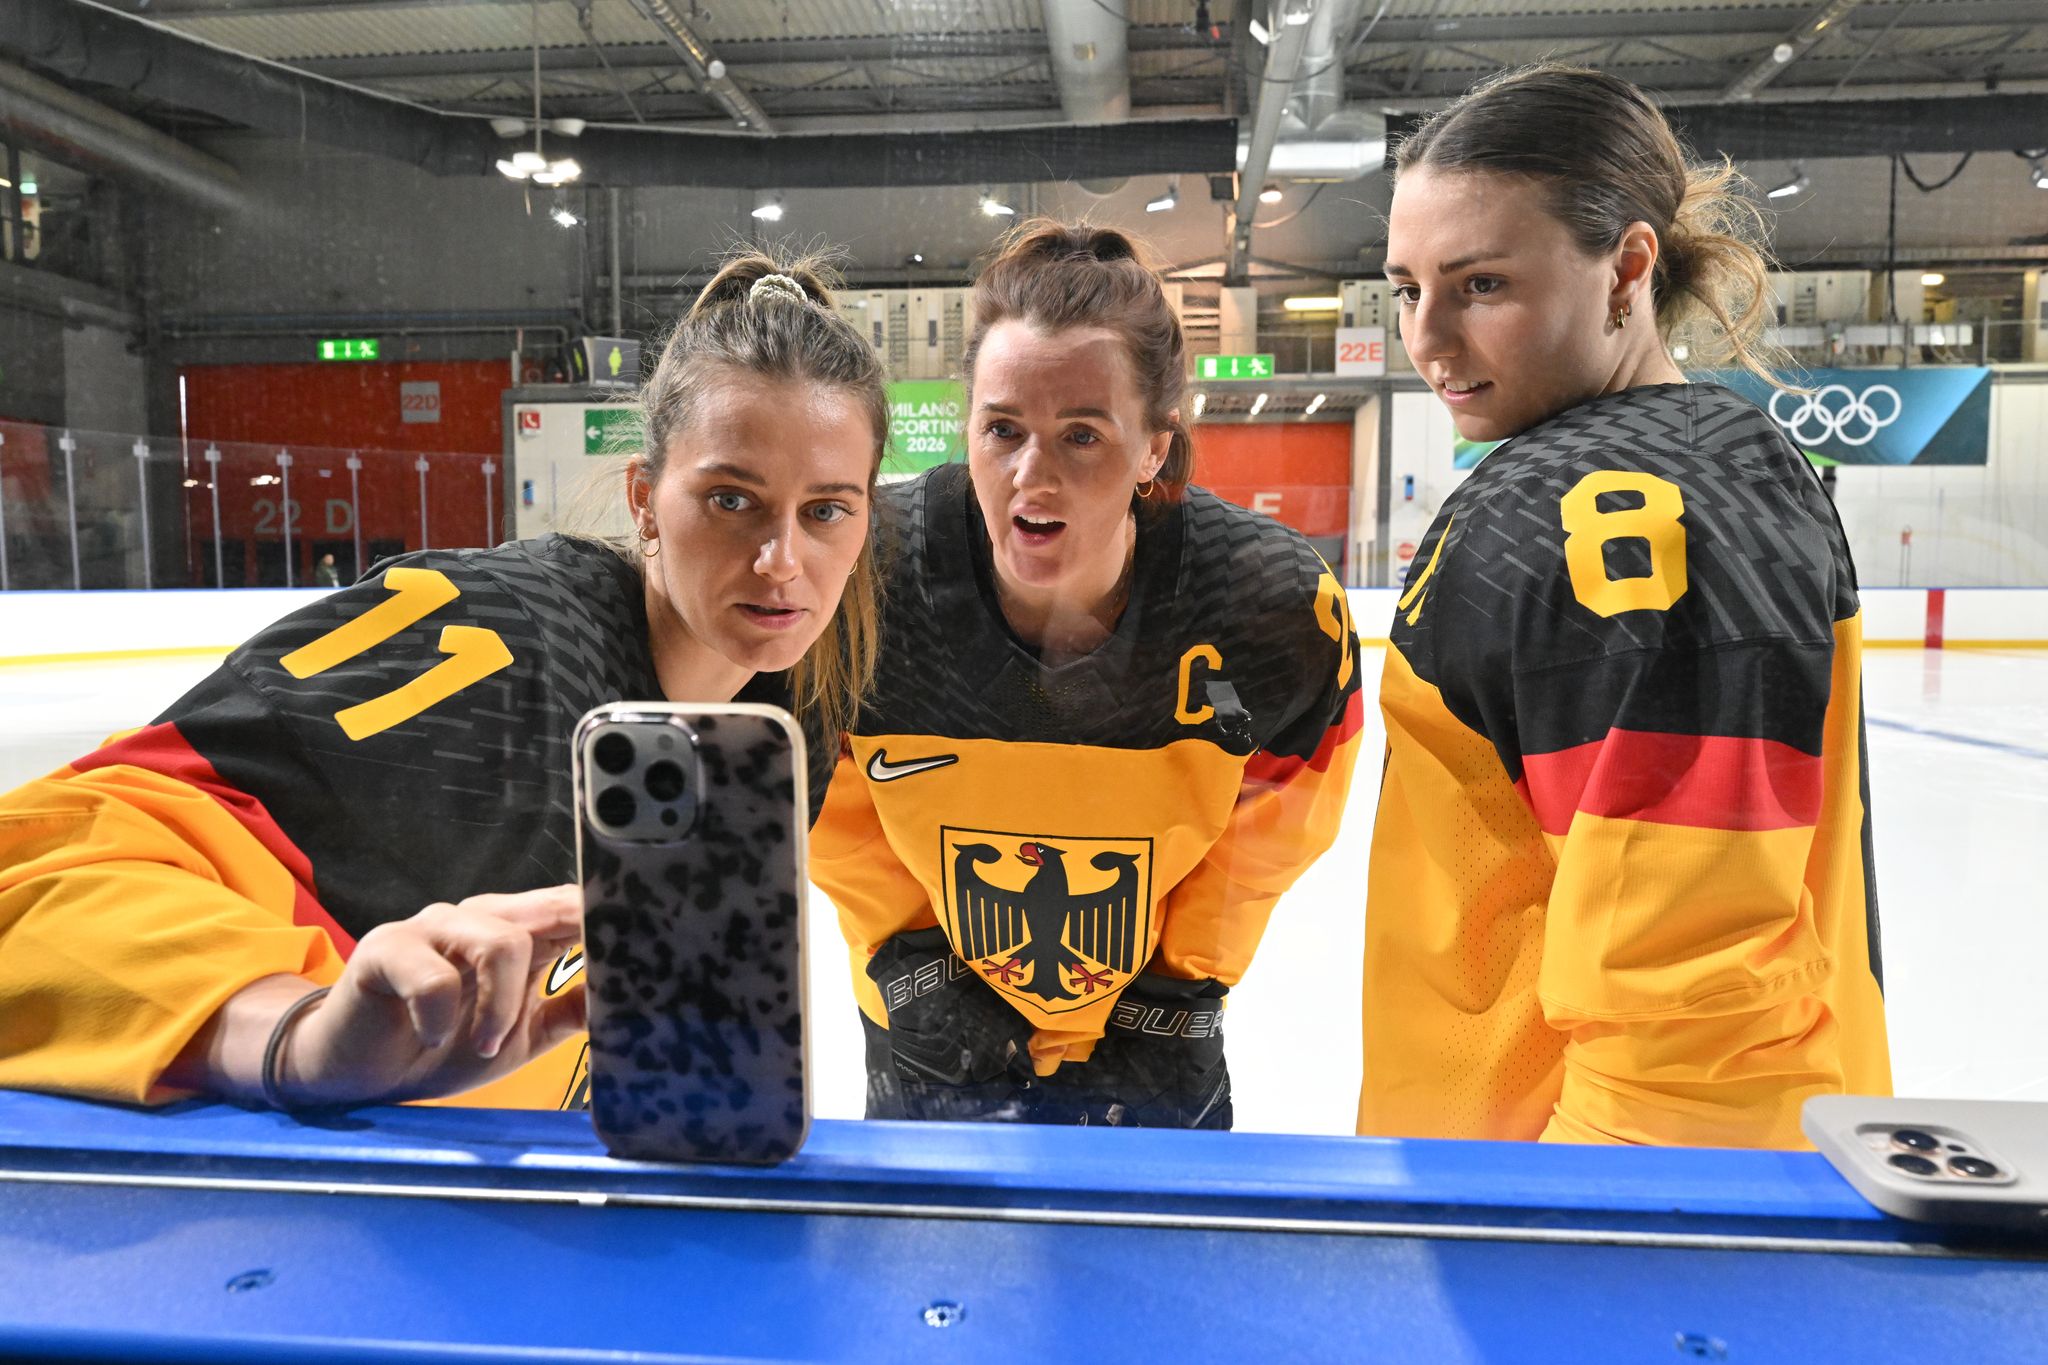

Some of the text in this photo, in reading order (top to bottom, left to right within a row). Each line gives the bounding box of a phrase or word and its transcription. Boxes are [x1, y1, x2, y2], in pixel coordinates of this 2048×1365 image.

[1340, 342, 1384, 362] 22E
[403, 394, 438, 410] 22D
[906, 436, 947, 452] 2026
[253, 498, 355, 534] 22 D
[1560, 470, 1688, 618] 8
[279, 567, 514, 741] 11
[1174, 644, 1222, 725] C
